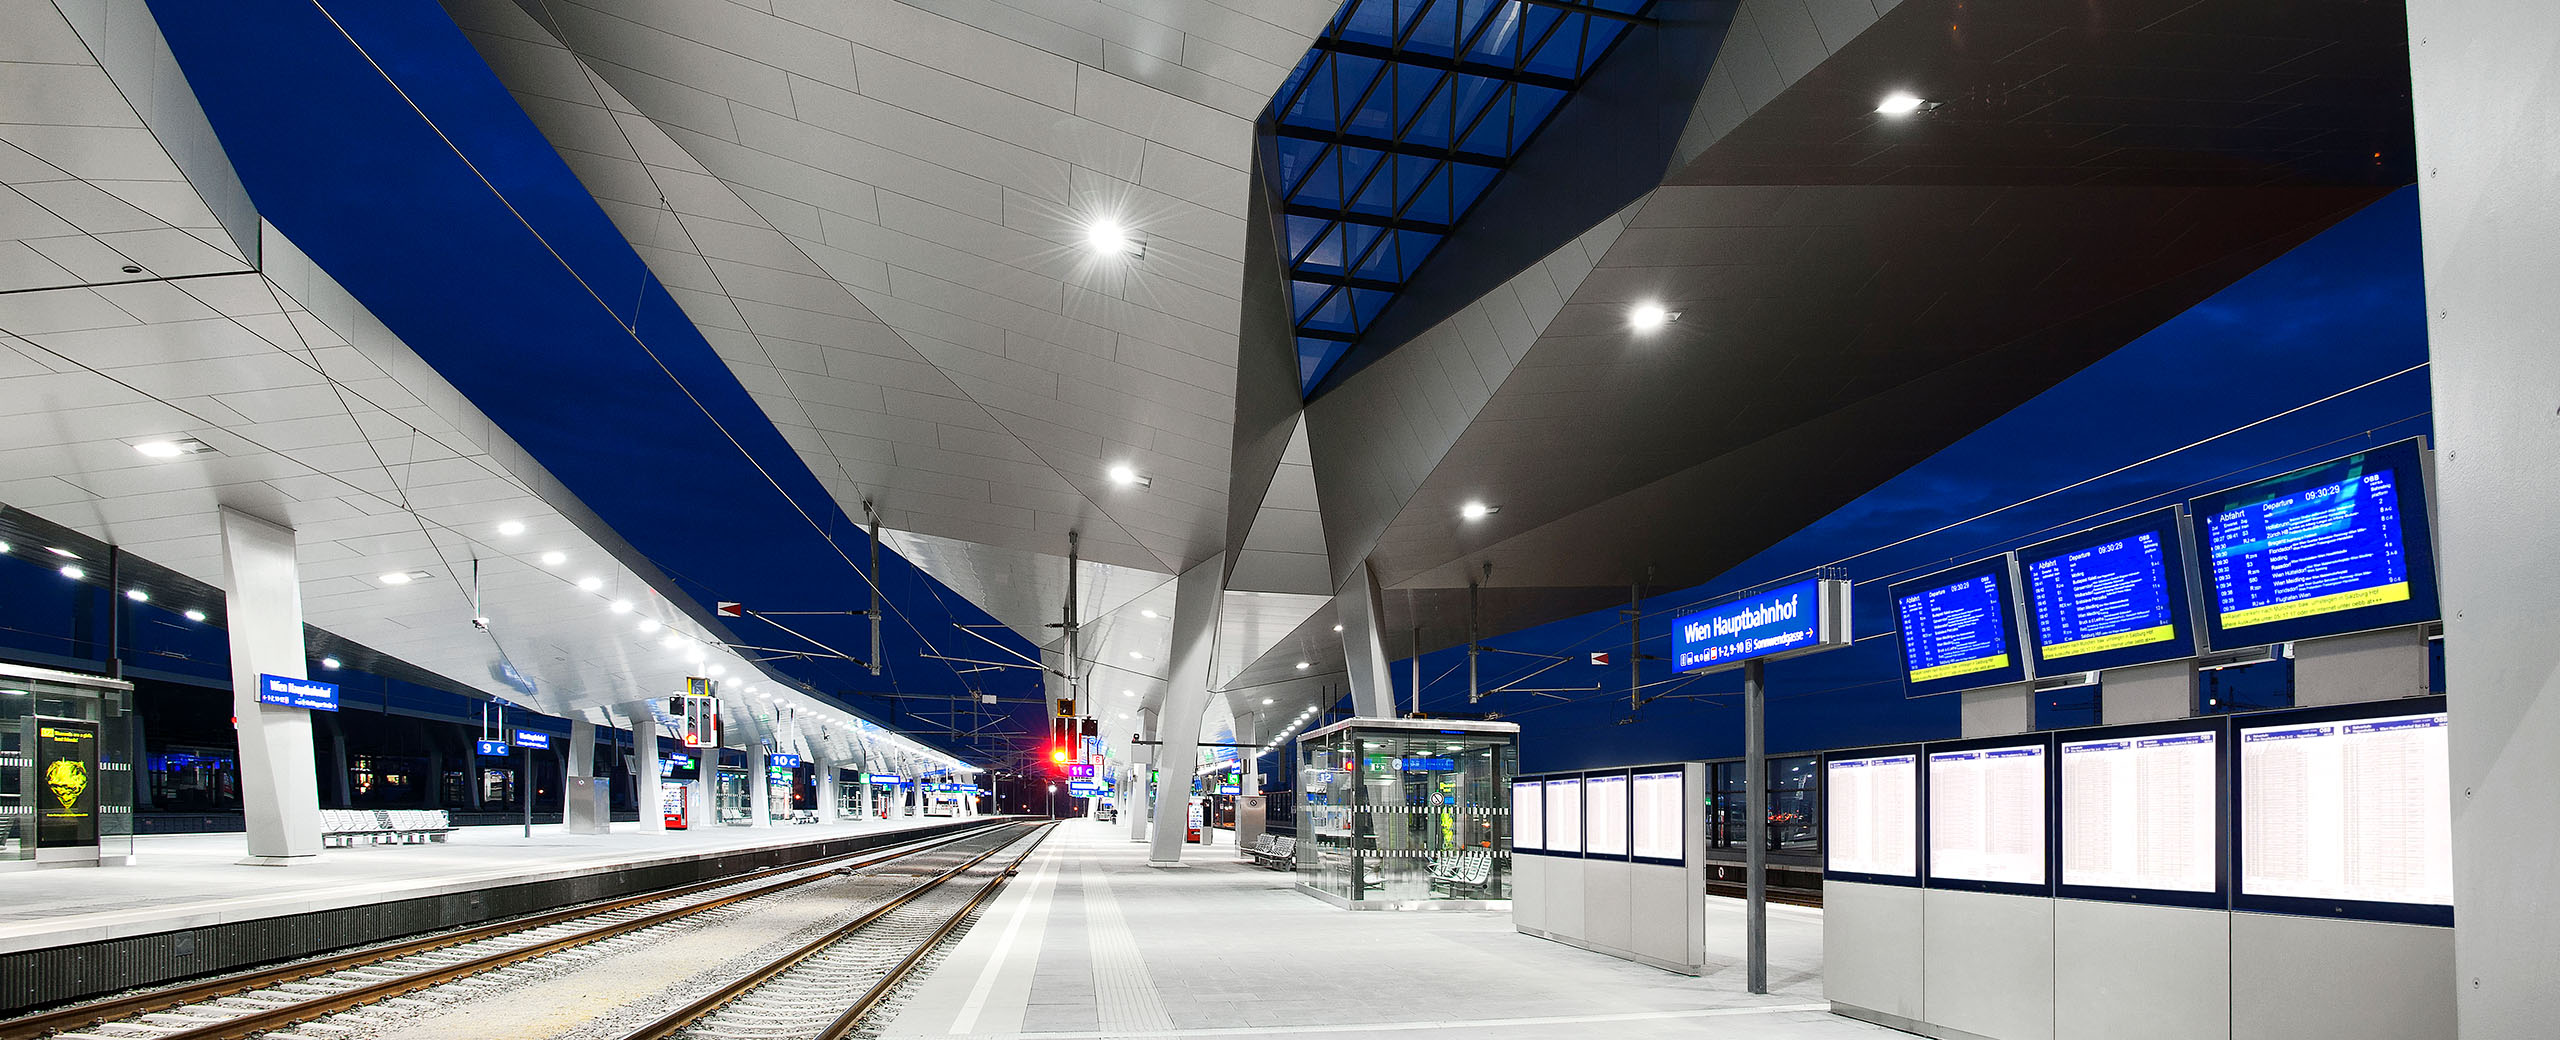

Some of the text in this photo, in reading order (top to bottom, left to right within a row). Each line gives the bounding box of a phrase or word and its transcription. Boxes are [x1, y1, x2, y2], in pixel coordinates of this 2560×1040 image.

[2220, 510, 2244, 522] Abfahrt
[2263, 499, 2293, 511] Departure
[2305, 485, 2340, 500] 09:30:29
[2269, 545, 2292, 554] Floridsdorf
[2039, 560, 2056, 569] Abfahrt
[2069, 552, 2090, 561] Departure
[2098, 542, 2122, 554] 09:30:29
[2344, 590, 2368, 600] Salzburg
[1684, 594, 1798, 644] Wien Hauptbahnhof
[483, 743, 491, 753] 9
[773, 756, 787, 766] 10
[1072, 766, 1082, 776] 11
